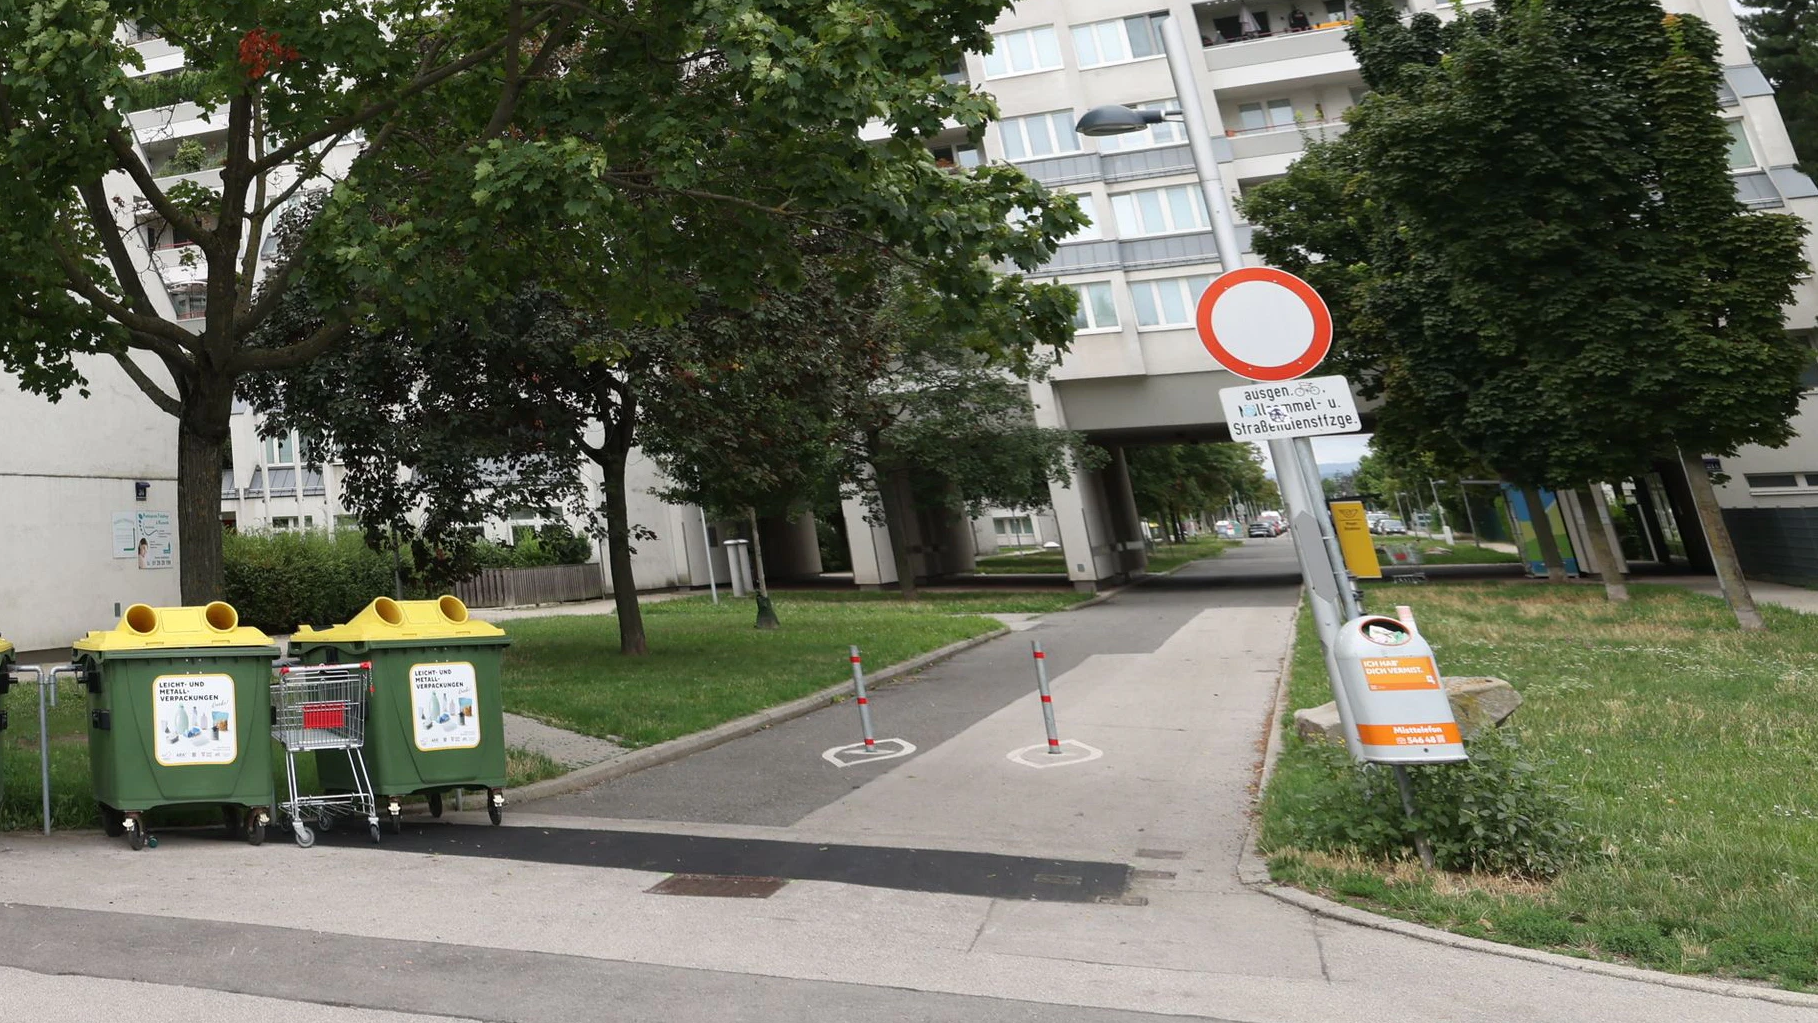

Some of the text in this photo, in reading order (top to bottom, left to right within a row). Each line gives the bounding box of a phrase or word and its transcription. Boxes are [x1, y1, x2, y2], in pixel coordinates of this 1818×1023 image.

[1244, 386, 1294, 402] ausgen.
[1327, 399, 1342, 409] u.
[414, 669, 438, 677] LEICHT-
[1388, 666, 1424, 674] VERMIST.
[416, 682, 464, 690] VERPACKUNGEN
[160, 694, 219, 702] VERPACKUNGEN
[1393, 725, 1443, 734] Misttelefon
[1406, 735, 1436, 744] 546 48
